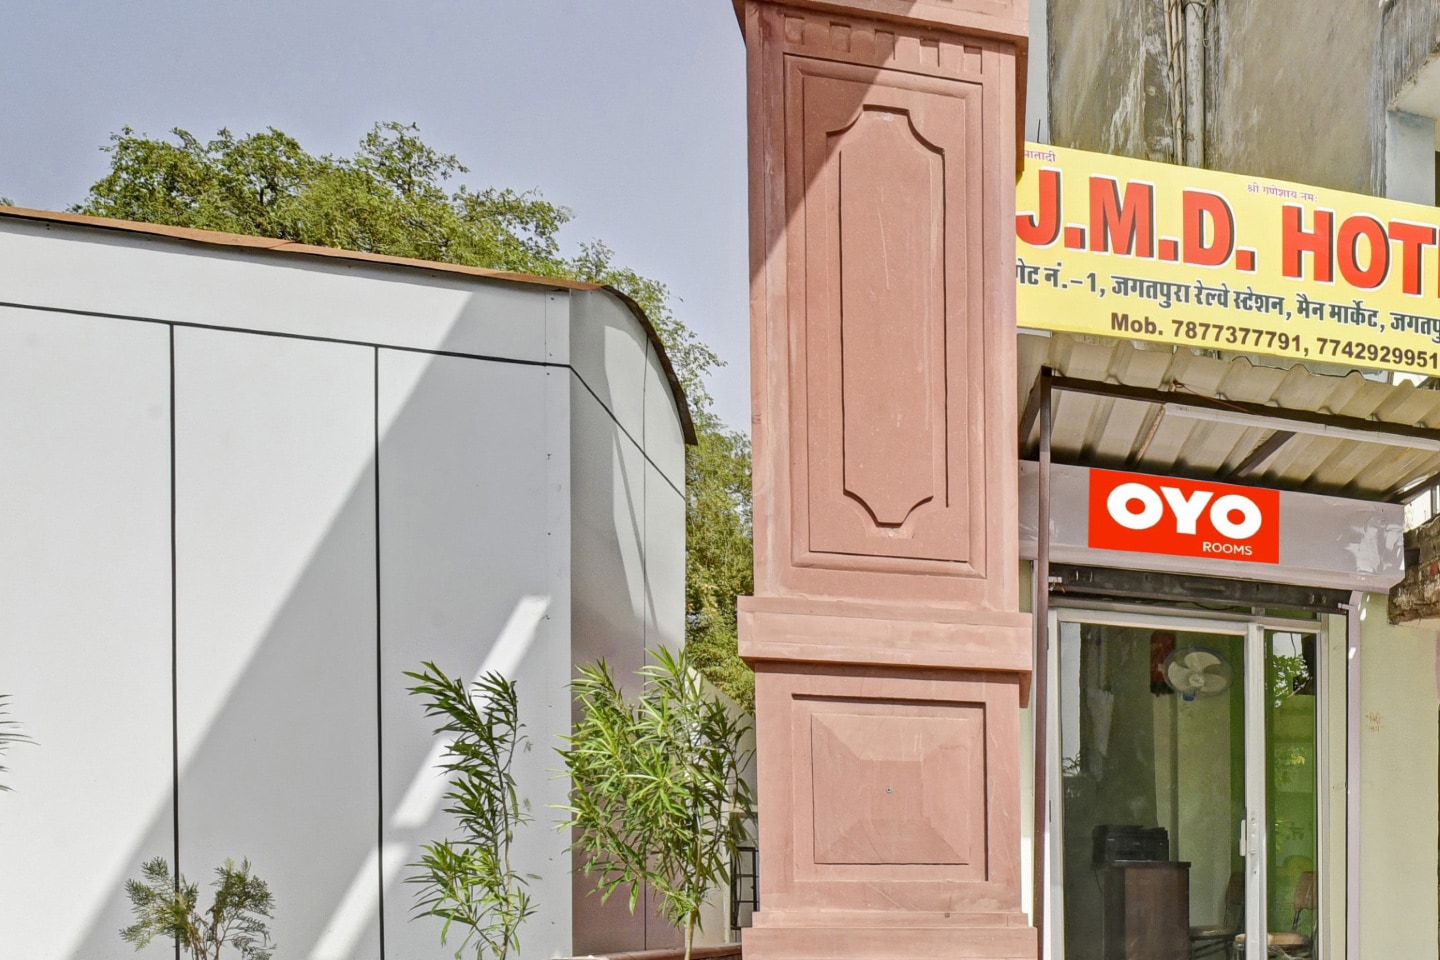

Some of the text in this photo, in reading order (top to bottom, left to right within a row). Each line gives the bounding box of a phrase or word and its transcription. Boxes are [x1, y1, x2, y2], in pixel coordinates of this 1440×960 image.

[1247, 182, 1259, 193] श्री
[1263, 185, 1297, 199] गणेशाय
[1016, 169, 1257, 272] J.M.D.
[1111, 275, 1191, 308] जगतपुरा
[1194, 280, 1230, 308] रेल्वे
[1233, 286, 1292, 320] स्टेशन,
[1296, 293, 1325, 320] मैन
[1329, 299, 1385, 332] मार्केट,
[1111, 312, 1438, 369] Mob. 7877377791, 7742929951
[1107, 482, 1262, 540] OYO
[1203, 541, 1253, 556] ROOMS
